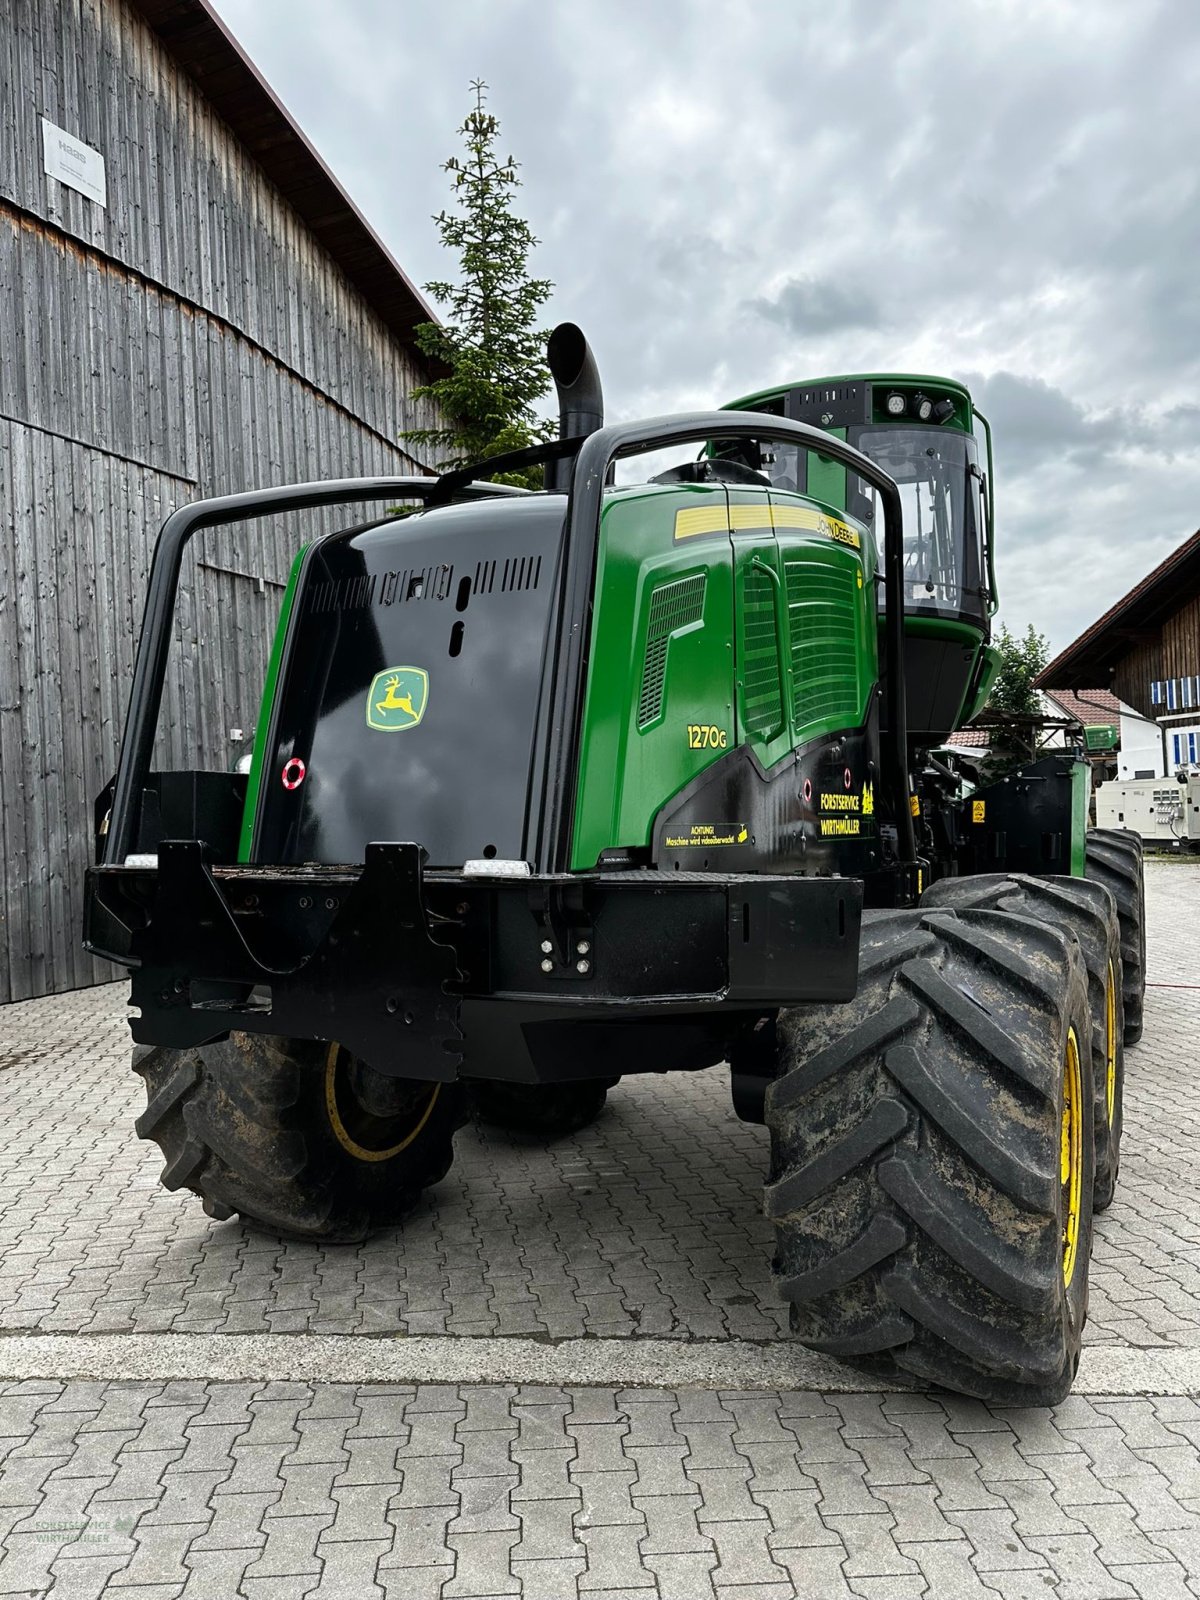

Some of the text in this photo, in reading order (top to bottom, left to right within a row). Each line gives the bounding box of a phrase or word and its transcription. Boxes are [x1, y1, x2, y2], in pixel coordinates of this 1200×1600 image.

[835, 523, 853, 543] DEERE
[687, 725, 727, 749] 1270G
[820, 793, 860, 810] FORSTSERVICE
[690, 826, 715, 835] ACHTUNG!
[820, 815, 860, 835] WIRTHMÜLLER
[666, 836, 689, 846] Maschine
[689, 835, 701, 845] wird
